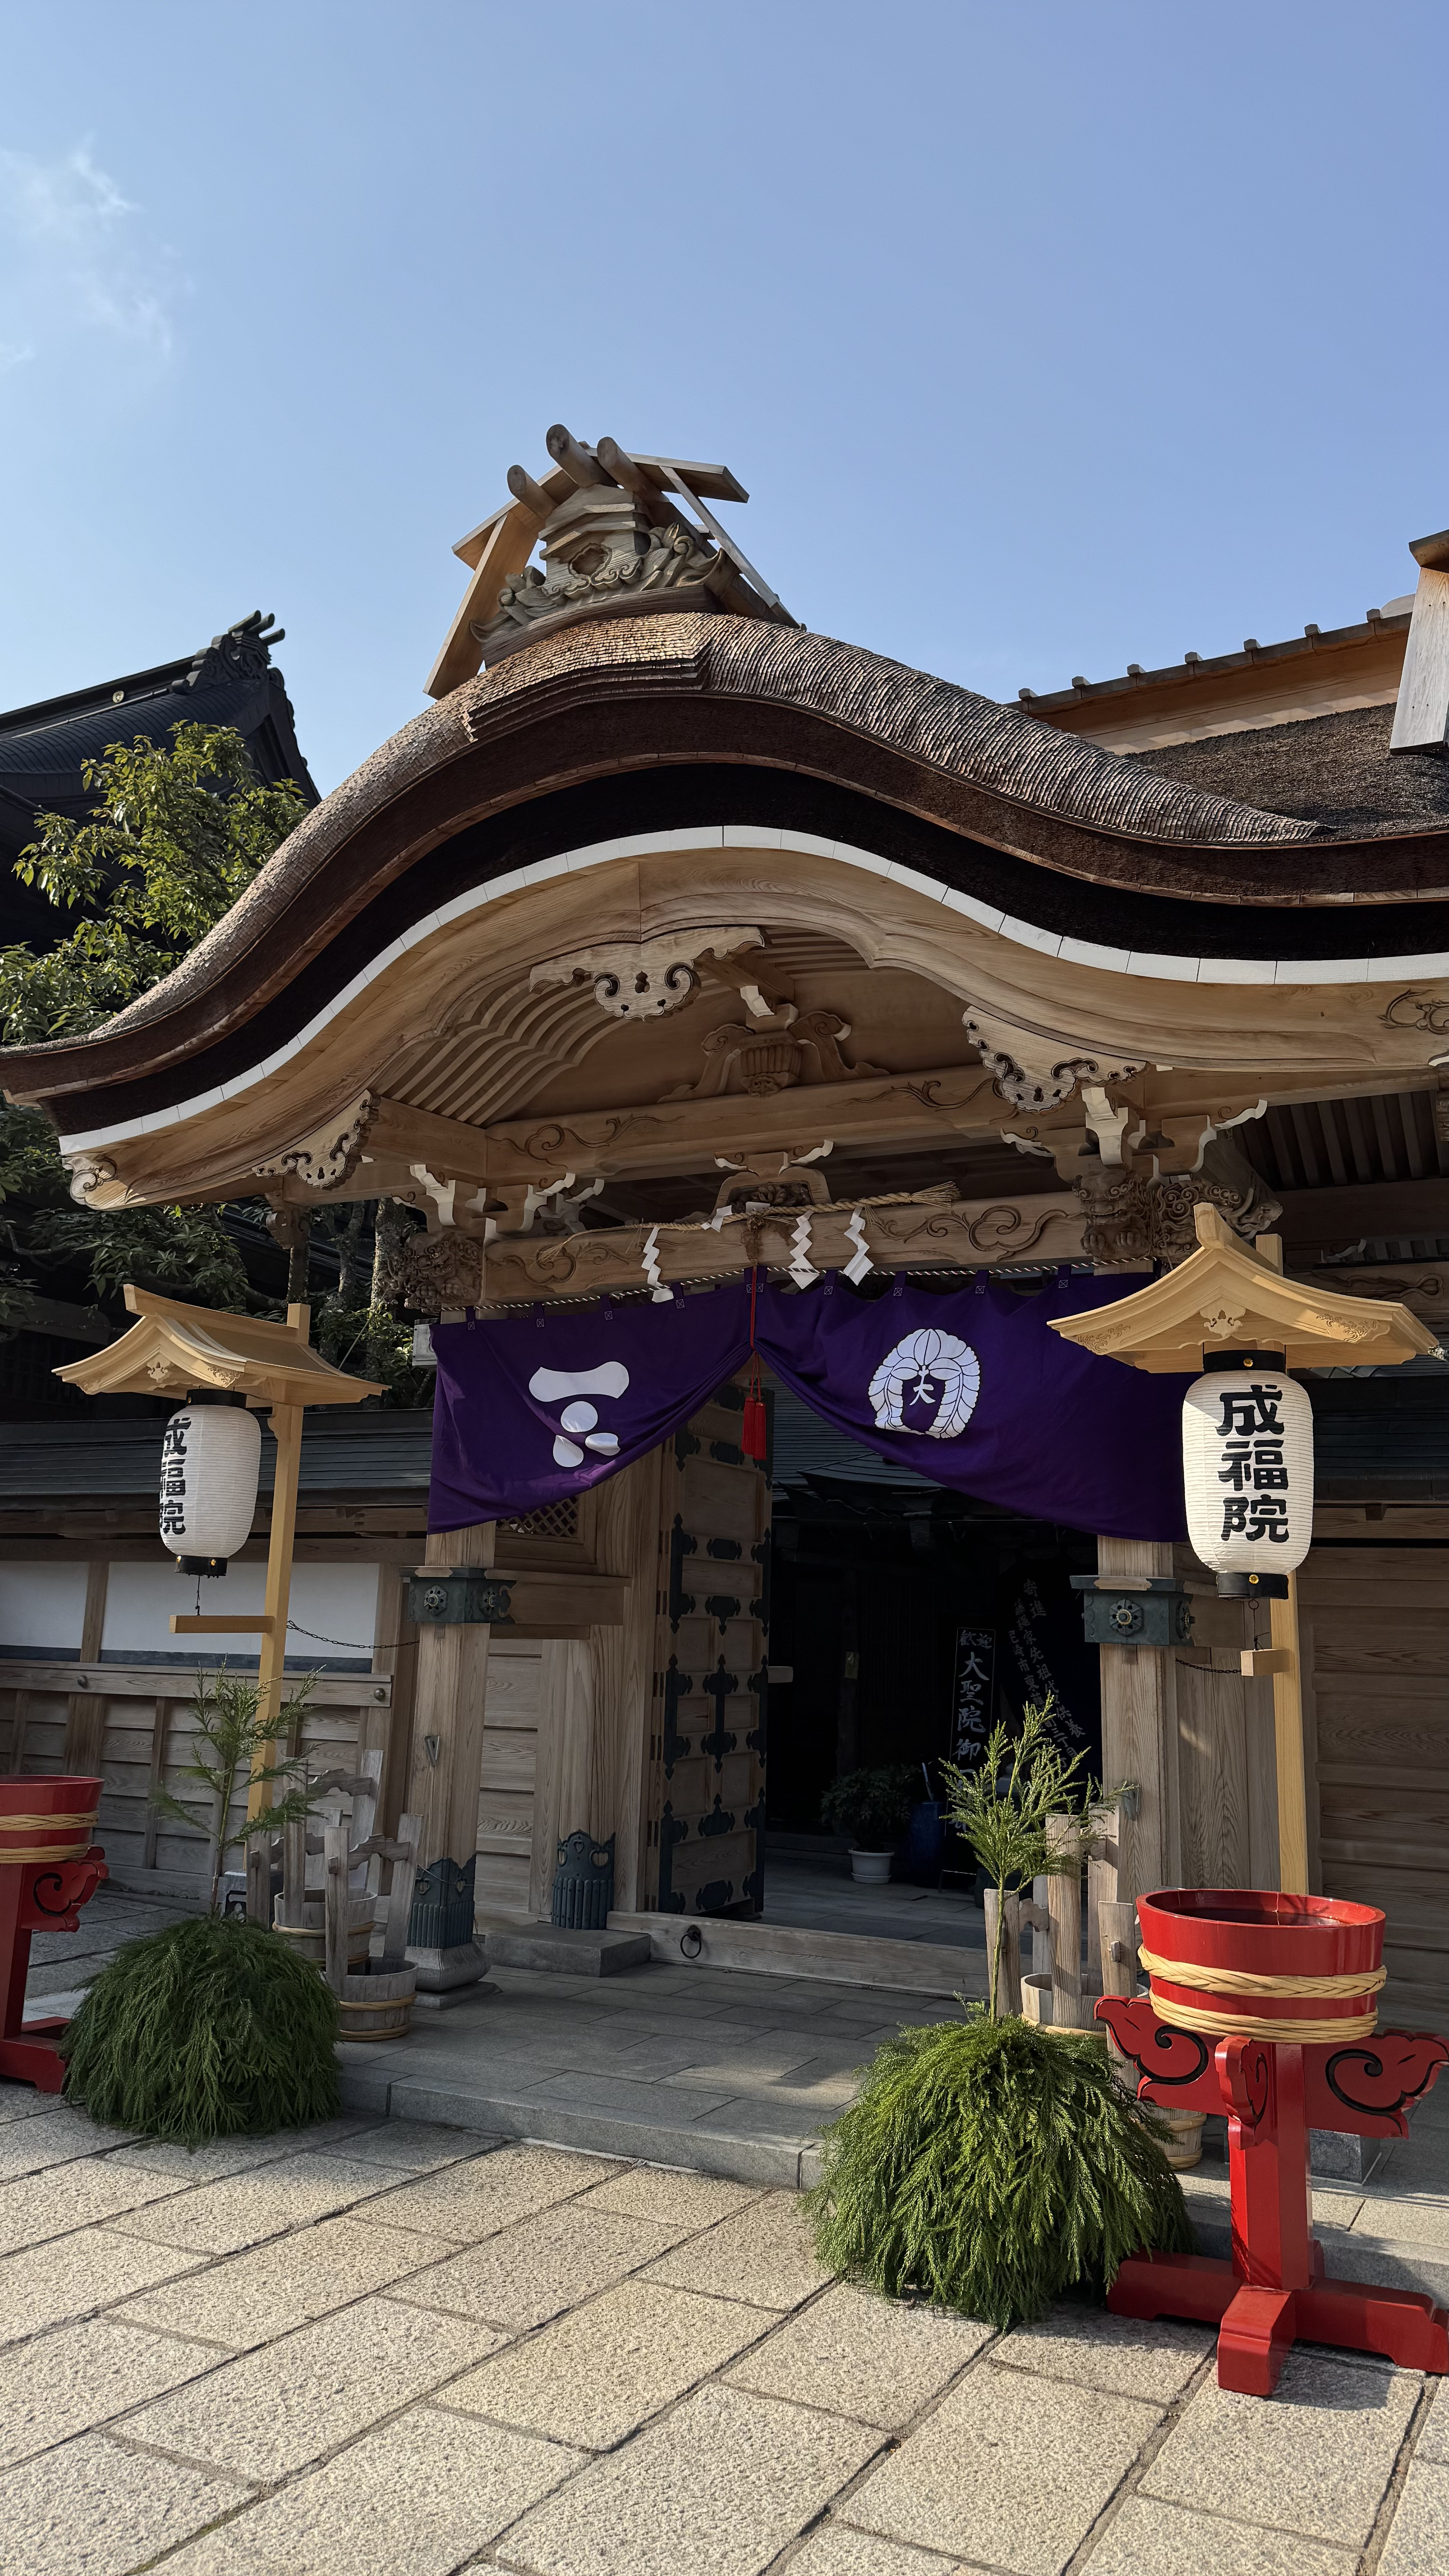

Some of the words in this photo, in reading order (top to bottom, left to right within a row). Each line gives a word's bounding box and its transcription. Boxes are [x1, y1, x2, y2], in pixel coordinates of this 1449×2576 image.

[910, 1368, 936, 1405] 大
[160, 1417, 191, 1535] 成福院
[1215, 1385, 1289, 1543] 成福院
[1024, 1578, 1048, 1619] 寄進
